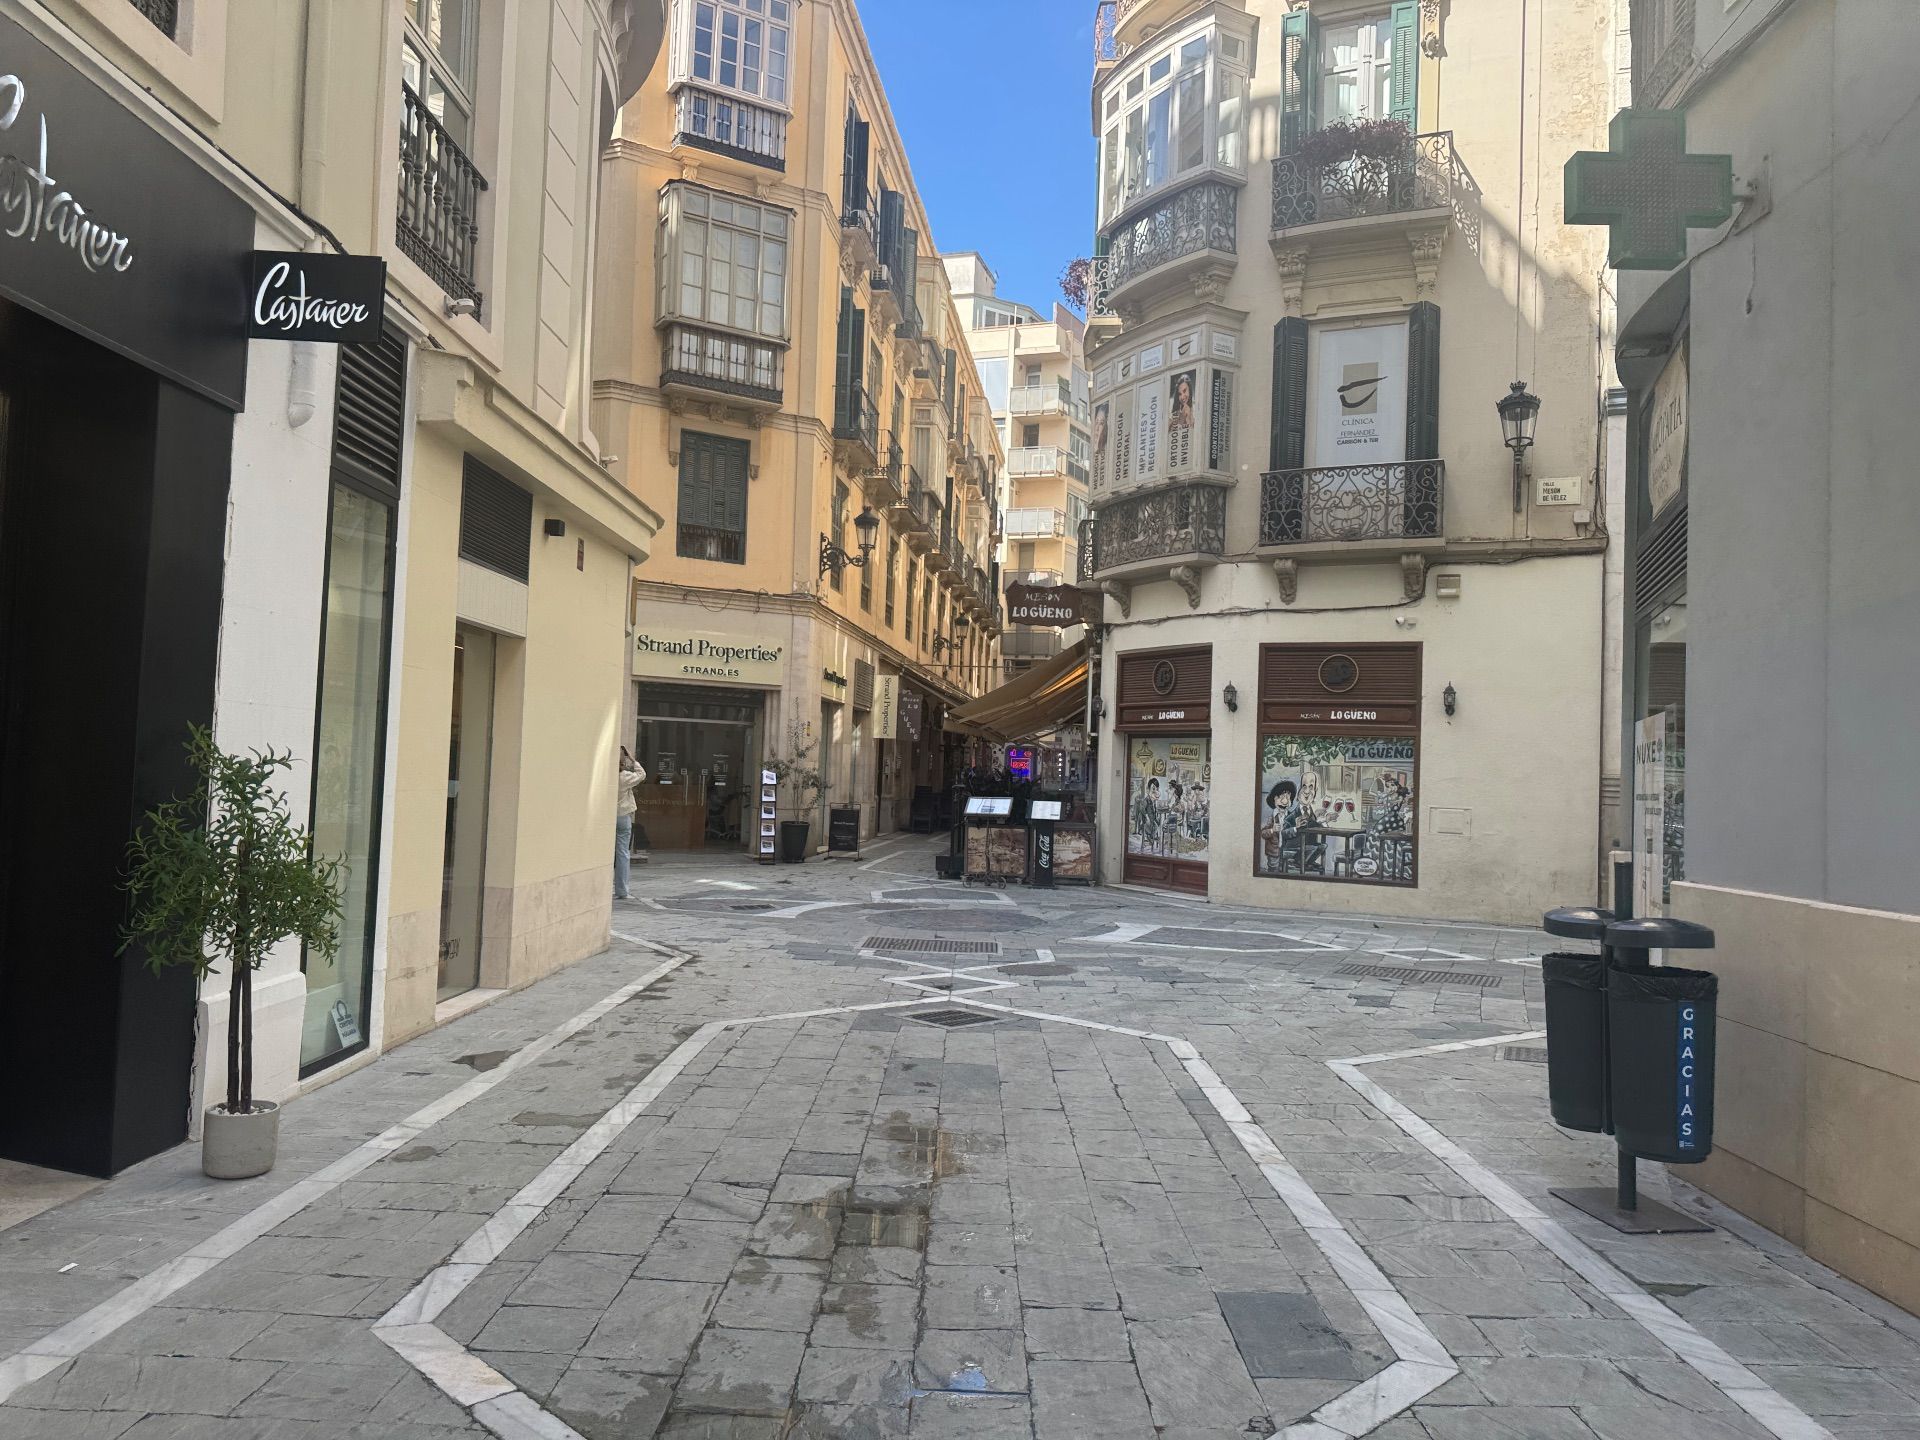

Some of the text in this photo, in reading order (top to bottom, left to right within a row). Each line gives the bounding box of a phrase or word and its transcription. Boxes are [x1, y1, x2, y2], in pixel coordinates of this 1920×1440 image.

[254, 261, 369, 330] Castañer
[1138, 419, 1147, 475] IMPLANTES
[1169, 410, 1179, 467] ORTODONCIA
[1180, 423, 1189, 466] INVISIBLE
[1123, 431, 1131, 478] INTEGRAL
[1542, 494, 1550, 502] DE
[1012, 604, 1073, 619] LO GÜENO
[637, 633, 694, 655] Strand
[682, 665, 740, 677] STRAND.ES
[884, 677, 892, 700] Strand
[1331, 710, 1343, 720] LO
[1344, 708, 1377, 720] GÜENO
[1350, 746, 1365, 759] LO
[1636, 740, 1656, 765] NUXE
[1681, 1008, 1695, 1136] GRACIAS
